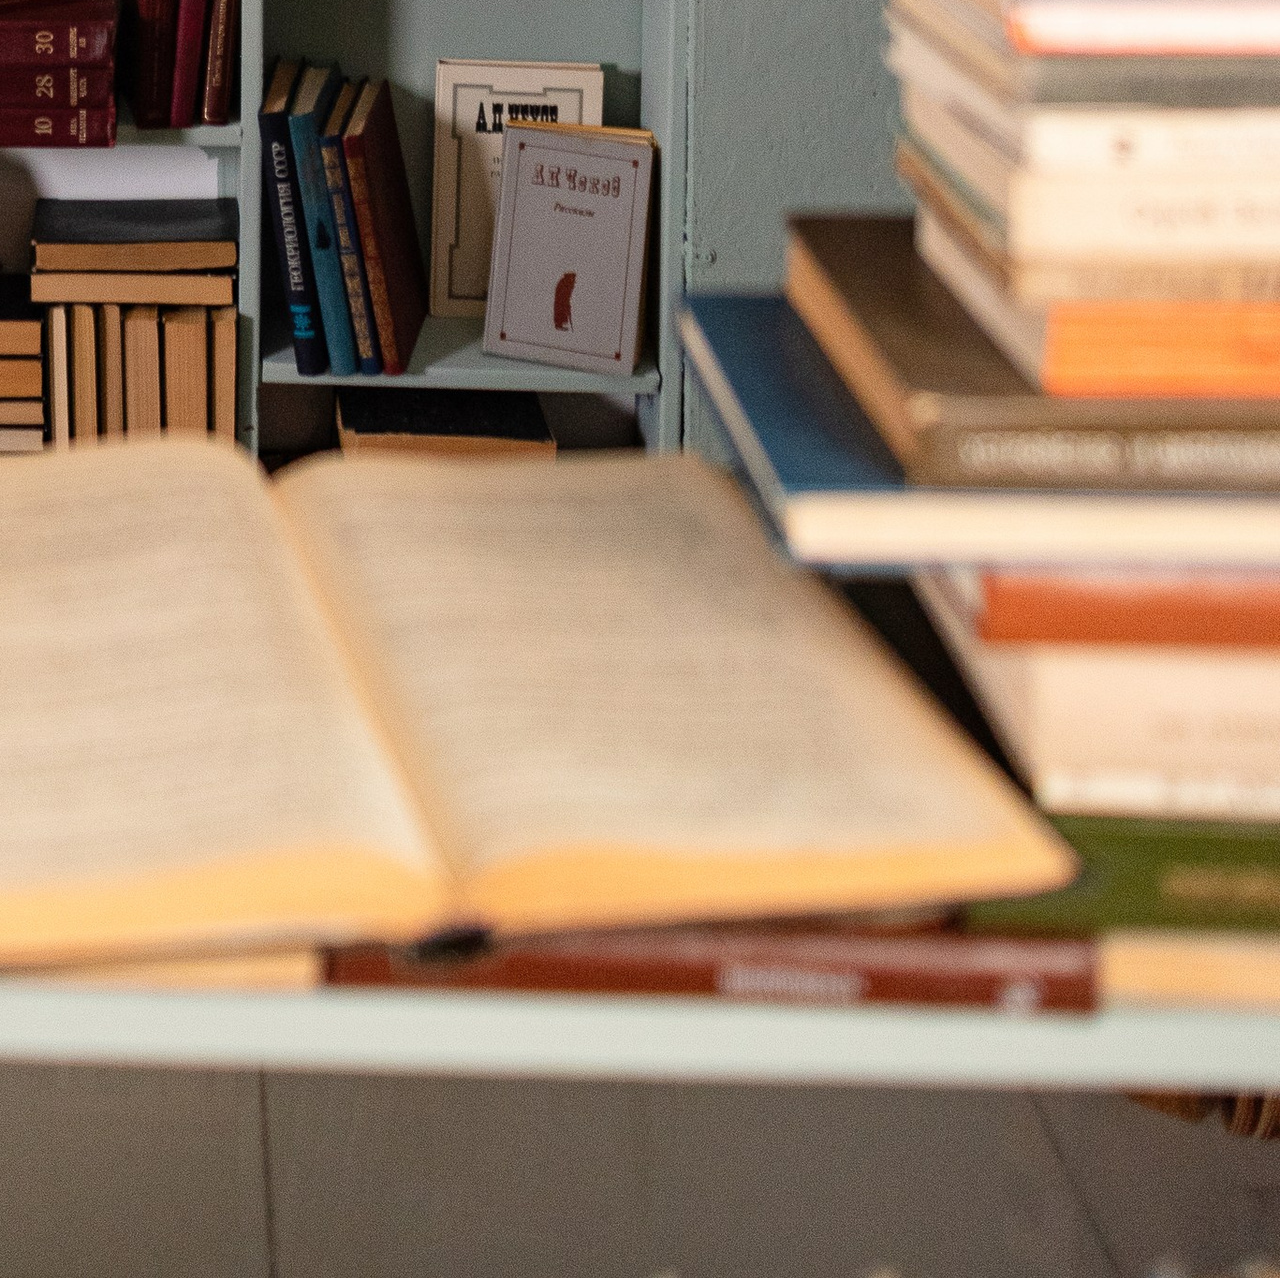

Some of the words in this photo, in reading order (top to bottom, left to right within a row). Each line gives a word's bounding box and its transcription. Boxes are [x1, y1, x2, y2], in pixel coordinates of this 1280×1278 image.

[35, 31, 54, 54] 30
[35, 74, 54, 98] 28
[35, 116, 53, 135] 10
[271, 141, 289, 179] СССР
[553, 202, 596, 219] Рассказы
[278, 181, 305, 292] ГЕОКРИОЛОГИЯ
